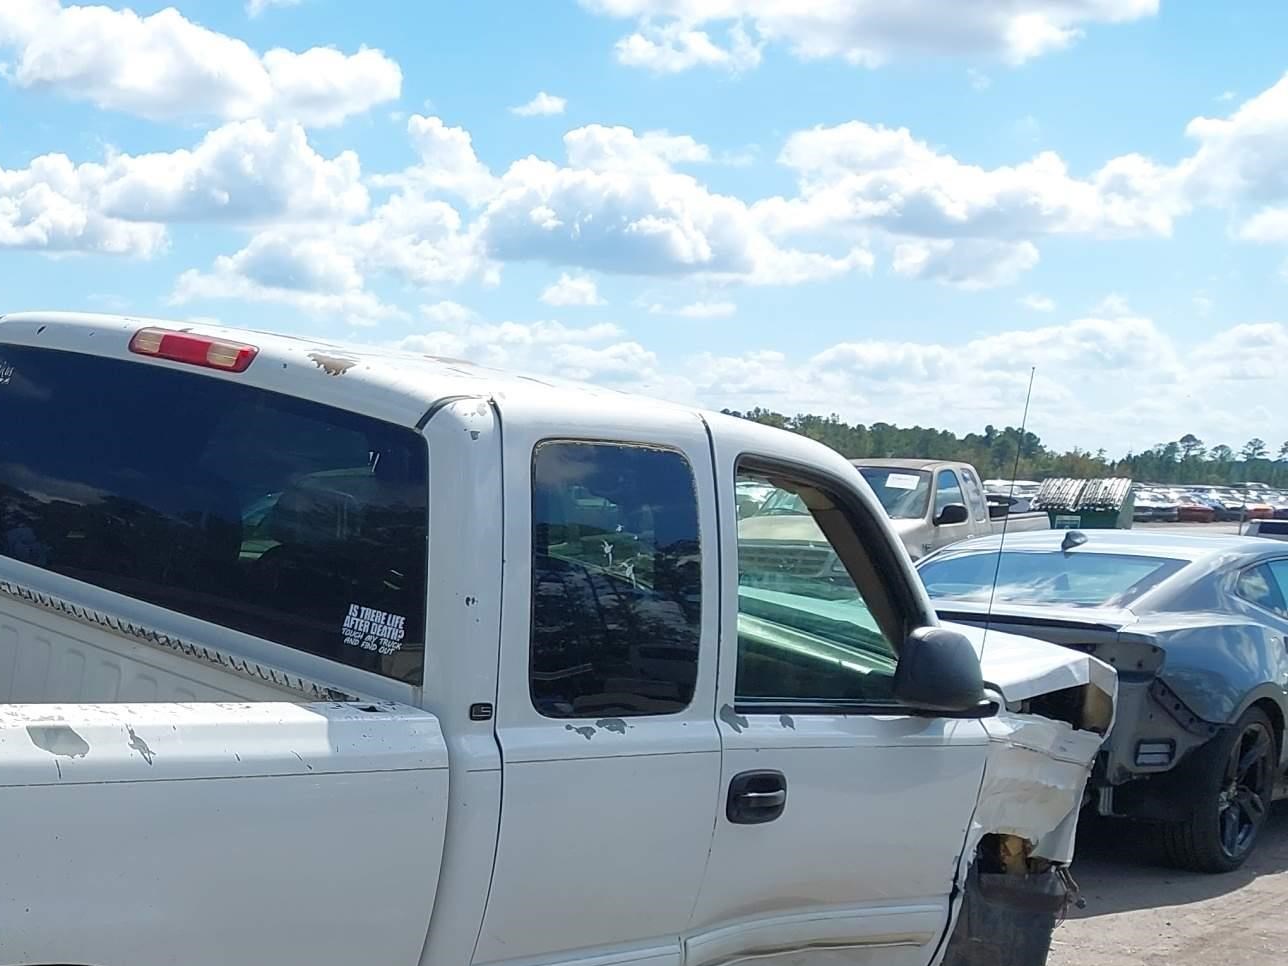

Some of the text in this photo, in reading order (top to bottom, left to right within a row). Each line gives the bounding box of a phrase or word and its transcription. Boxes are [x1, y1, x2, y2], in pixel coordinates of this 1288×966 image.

[348, 603, 406, 629] IS THERE LIFE
[342, 628, 403, 650] TOUCH MY TRUCK
[343, 615, 405, 642] AFTER DEATH?
[343, 636, 396, 655] AND FIND OUT
